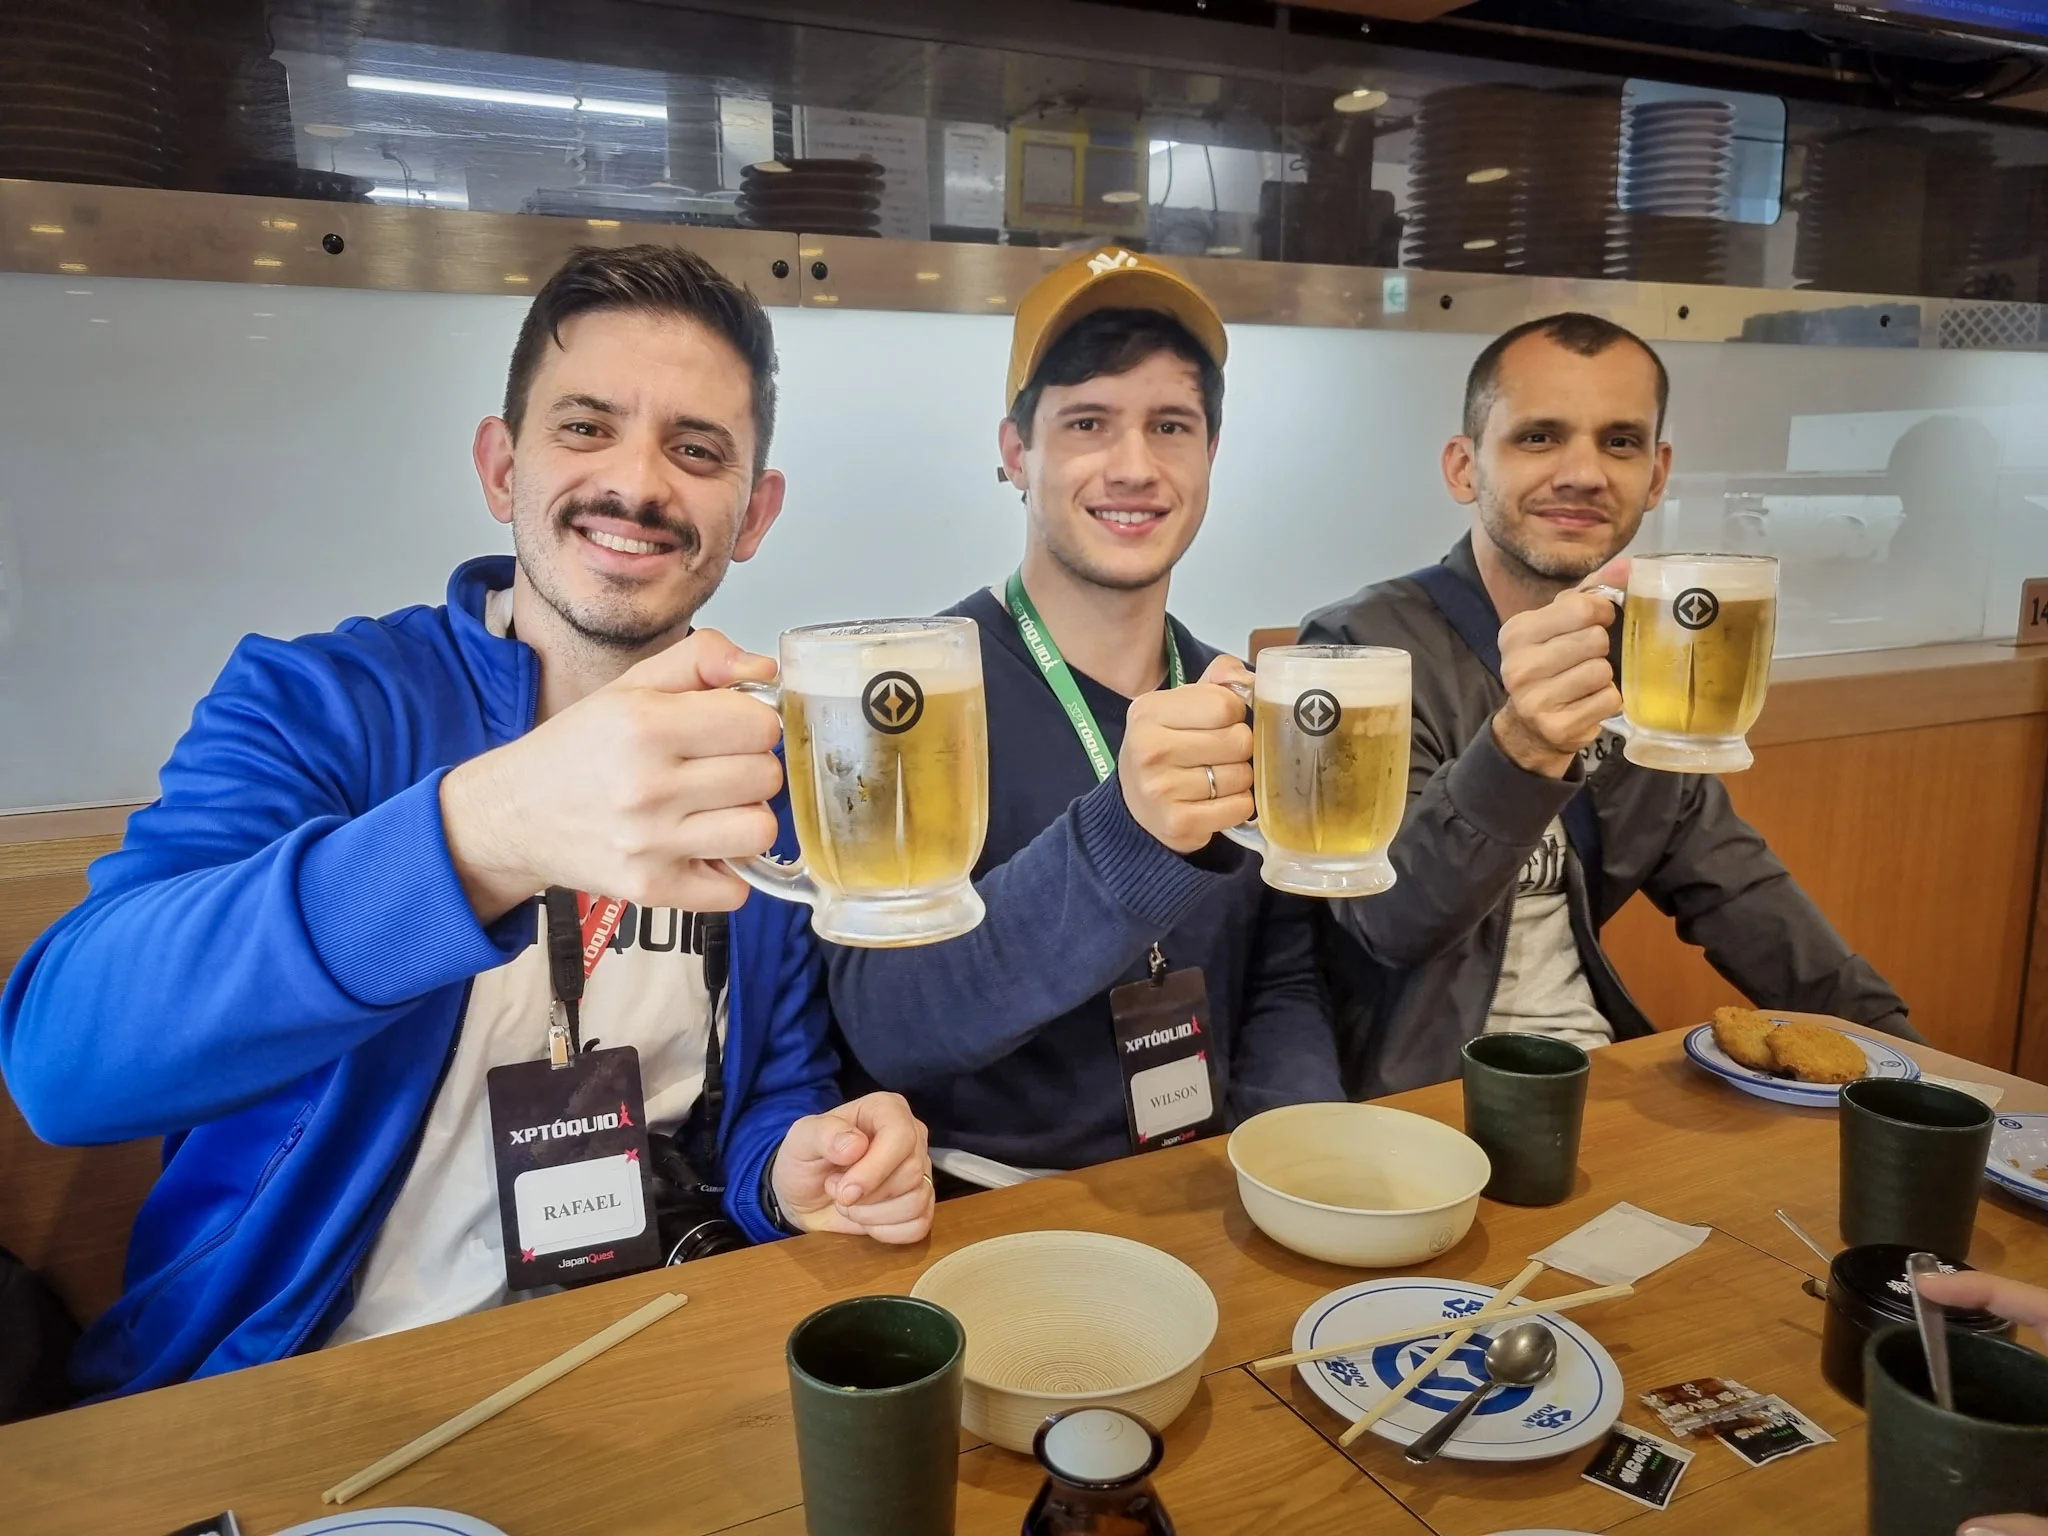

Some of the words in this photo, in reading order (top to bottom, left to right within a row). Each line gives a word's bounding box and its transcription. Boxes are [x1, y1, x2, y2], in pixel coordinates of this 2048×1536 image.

[1125, 1022, 1193, 1053] XPTÓQUIO
[1150, 1084, 1199, 1109] WILSON
[510, 1111, 618, 1145] XPTÓQUIO
[543, 1193, 621, 1221] RAFAEL
[1345, 1362, 1369, 1387] KURA
[1522, 1404, 1557, 1422] KURA
